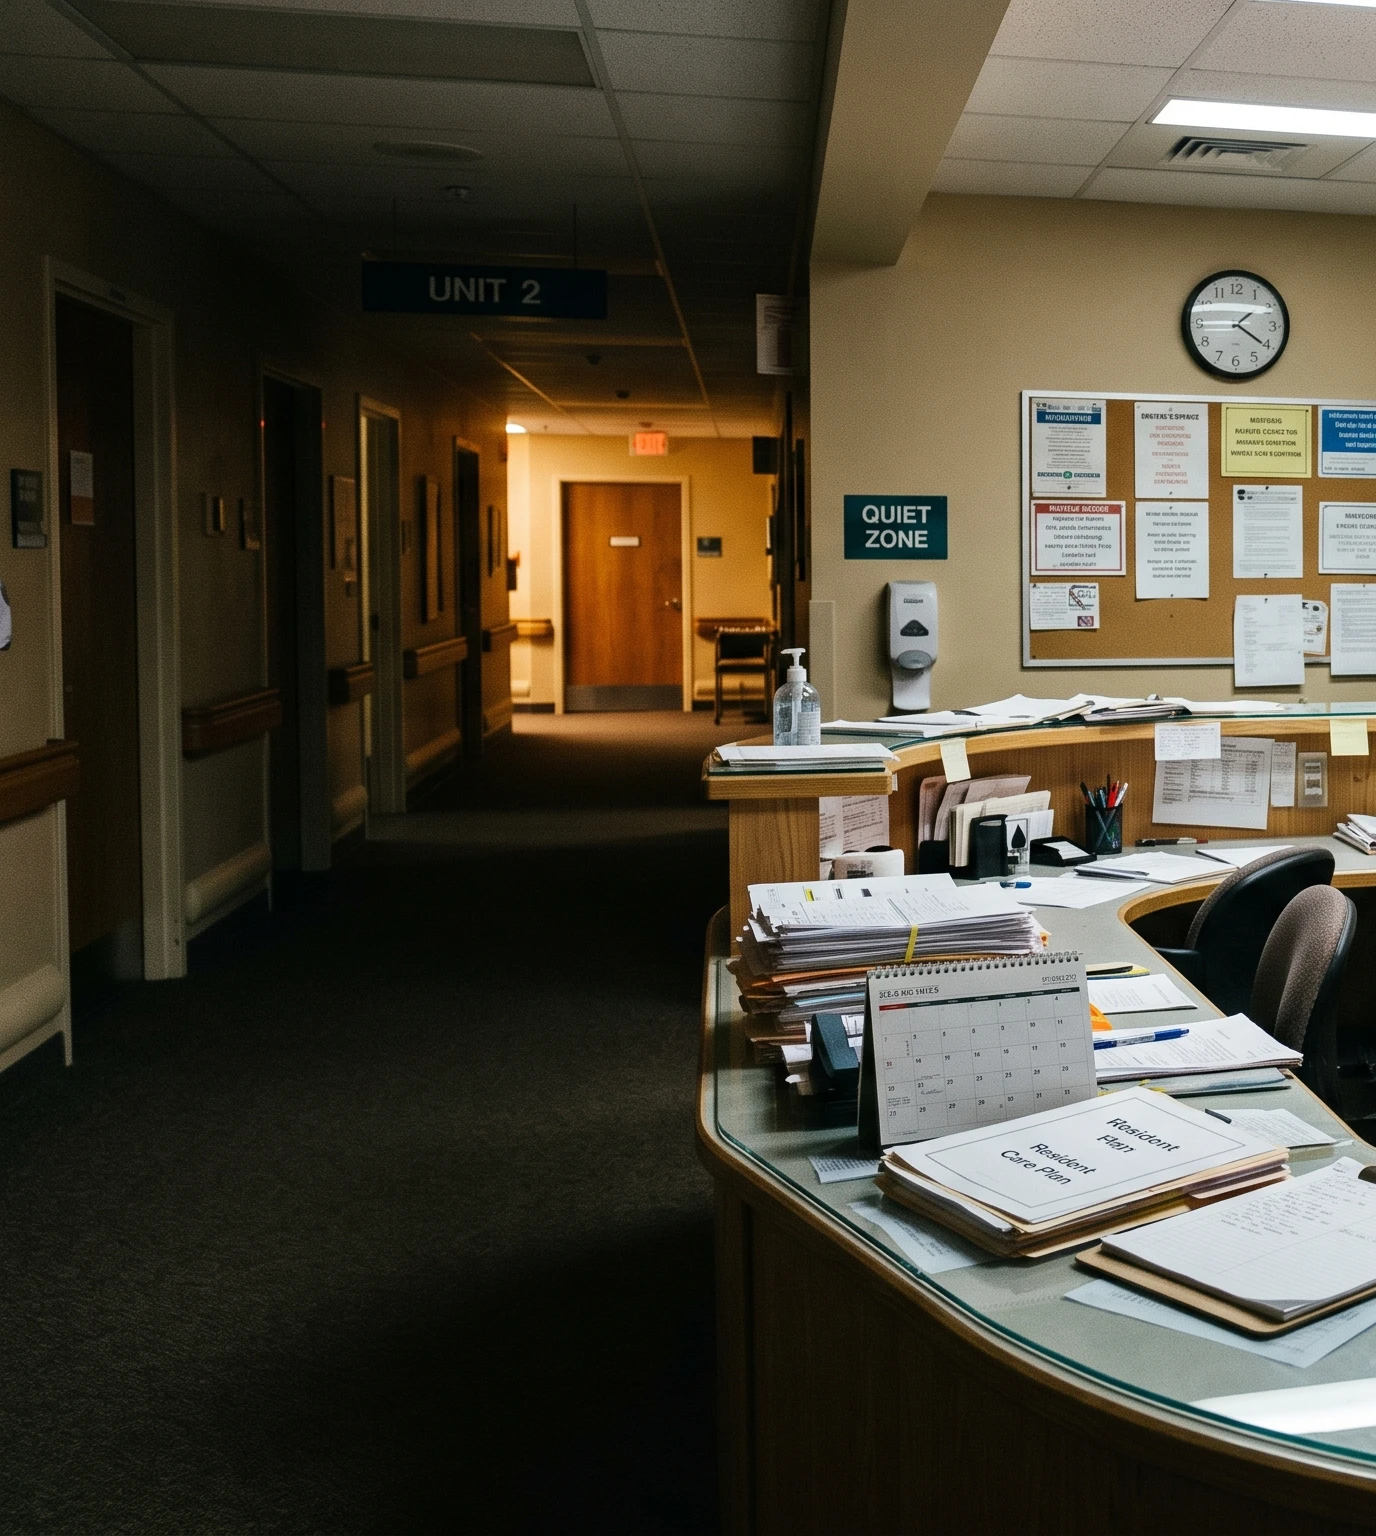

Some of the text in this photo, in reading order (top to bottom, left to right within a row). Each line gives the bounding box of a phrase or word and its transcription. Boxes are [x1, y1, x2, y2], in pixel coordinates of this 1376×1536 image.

[429, 276, 541, 304] UNIT 2
[1214, 287, 1224, 298] 11
[1230, 283, 1244, 295] 12
[1268, 321, 1277, 332] 3
[1201, 336, 1210, 347] 8
[1262, 339, 1271, 350] 4
[1215, 350, 1224, 361] 7
[1231, 355, 1240, 367] 6
[1250, 351, 1258, 363] 5
[862, 504, 931, 524] QUIET
[865, 530, 928, 548] ZONE
[1029, 1143, 1097, 1174] Resident
[1001, 1150, 1071, 1185] Care Plan
